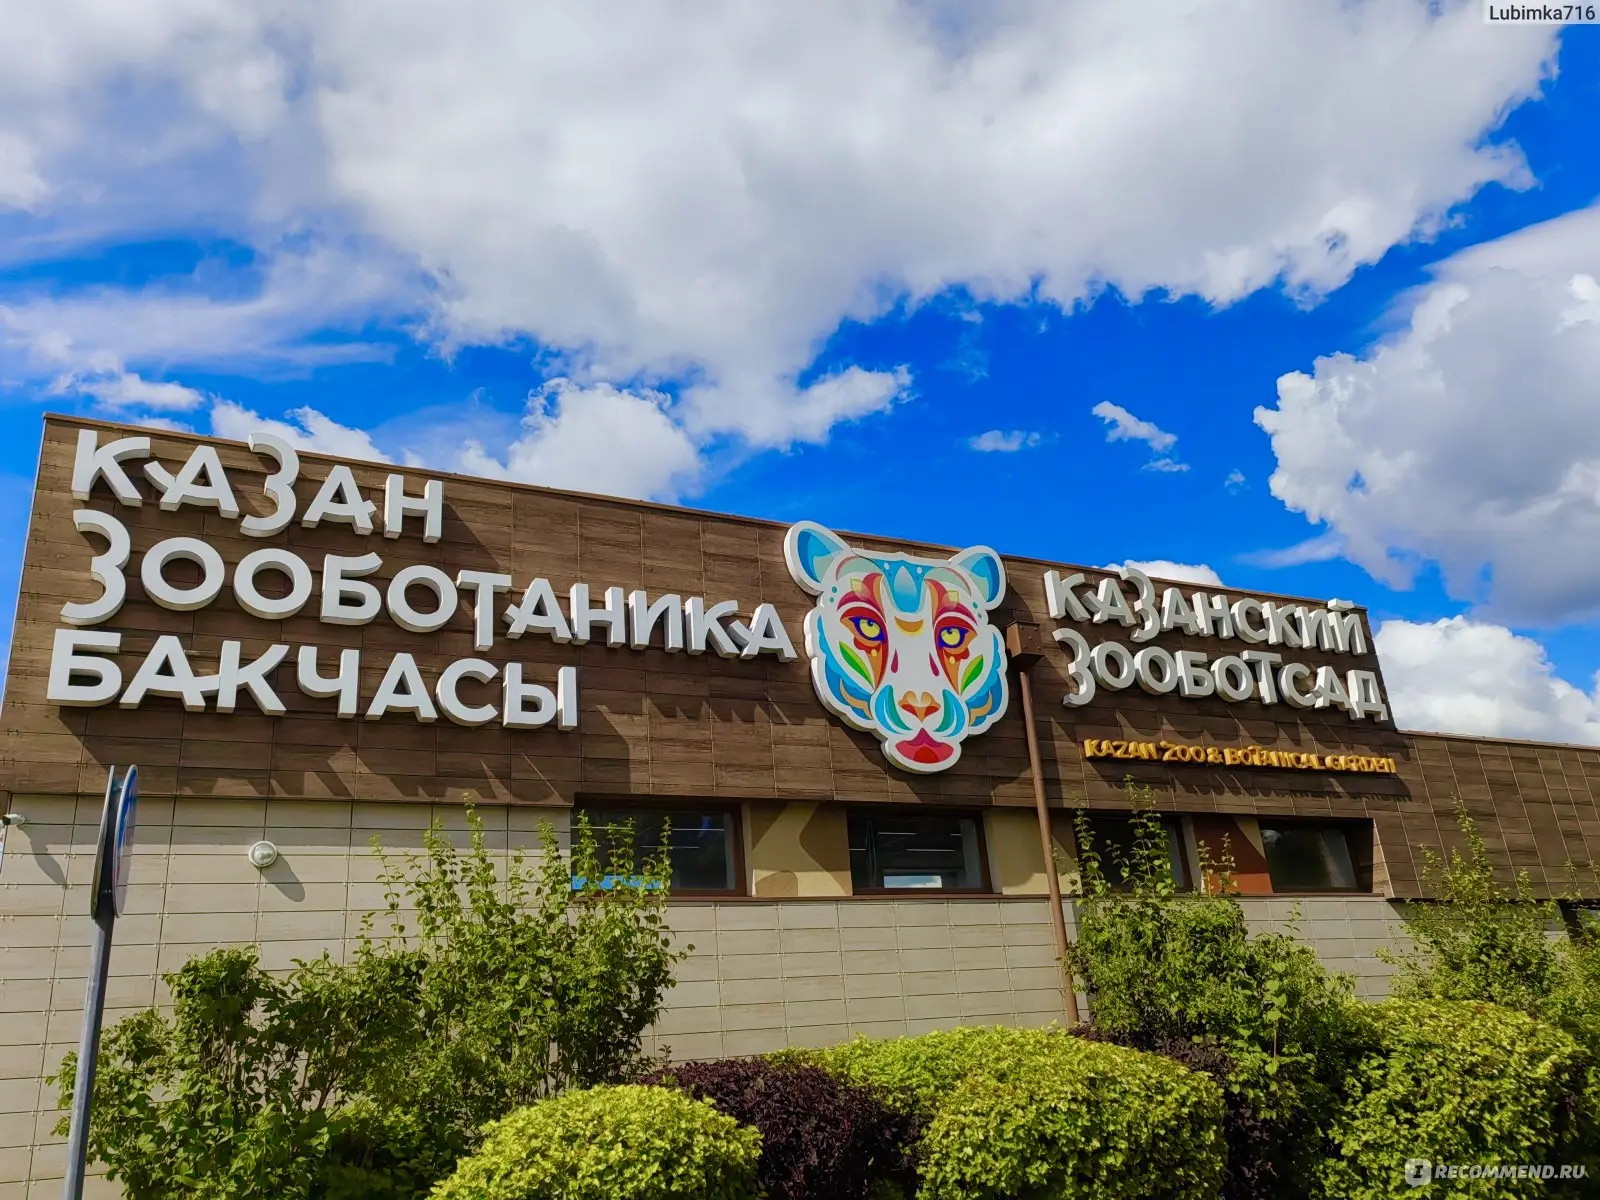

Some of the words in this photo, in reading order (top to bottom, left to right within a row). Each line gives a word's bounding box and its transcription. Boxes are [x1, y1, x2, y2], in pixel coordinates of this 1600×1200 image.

[71, 429, 443, 543] КАЗАН
[60, 509, 797, 662] ЗООБОТАНИКА
[1044, 568, 1368, 655] КАЗАНСКИЙ
[47, 629, 578, 731] БАКЧАСЫ
[1052, 628, 1389, 722] ЗООБОТСАД
[1083, 738, 1157, 760] KAZAN
[1159, 740, 1205, 763] ZOO
[1207, 747, 1223, 764] &
[1223, 745, 1325, 770] BOTANICAL
